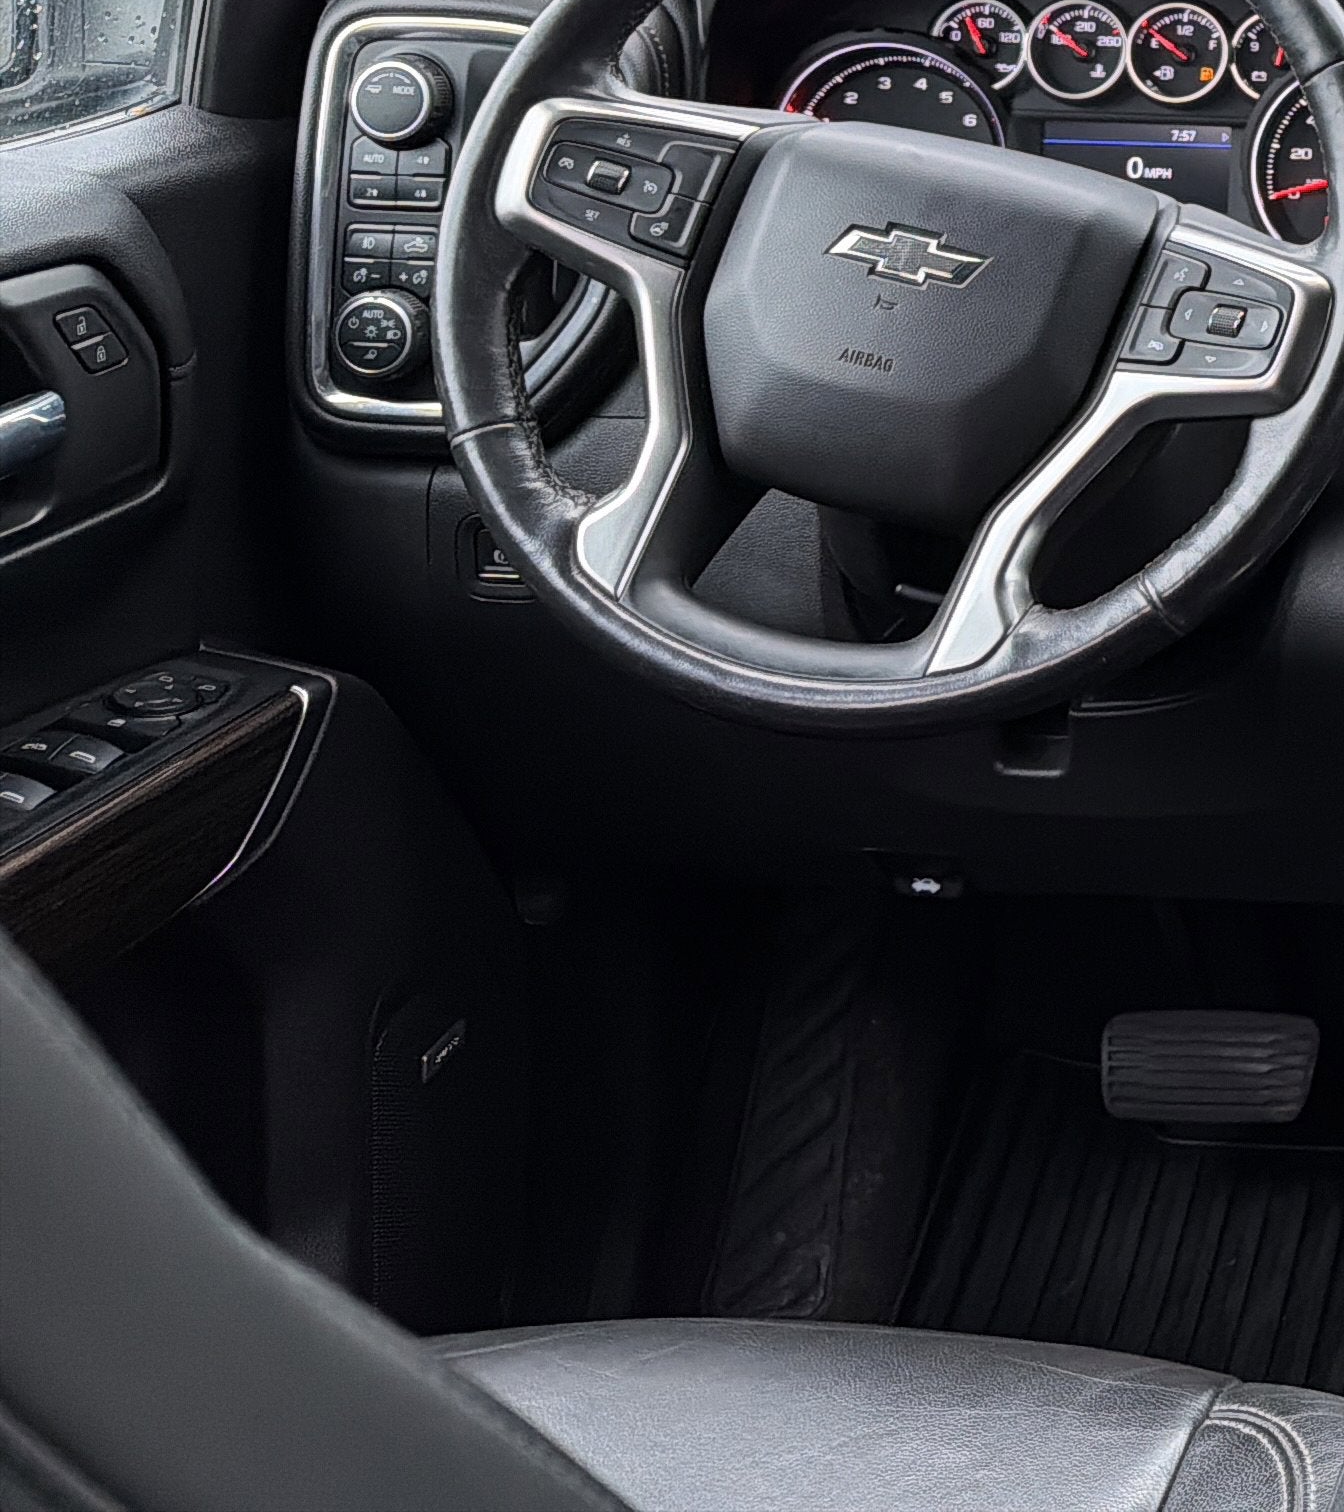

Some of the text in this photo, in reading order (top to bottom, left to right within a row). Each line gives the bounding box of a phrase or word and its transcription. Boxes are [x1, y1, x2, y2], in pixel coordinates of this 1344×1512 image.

[976, 18, 995, 29] 60
[1074, 21, 1096, 32] 210
[951, 30, 961, 41] 0
[1176, 25, 1194, 36] 1/2
[999, 32, 1021, 43] 120
[1097, 36, 1122, 47] 260
[1150, 38, 1159, 49] E
[1208, 40, 1218, 50] F
[1250, 42, 1260, 52] 9
[878, 76, 892, 90] 3
[913, 77, 928, 90] 4
[392, 85, 416, 96] MODE
[843, 91, 859, 105] 2
[939, 91, 953, 104] 5
[962, 113, 977, 127] 6
[1170, 130, 1197, 142] 7:57
[363, 154, 385, 163] AUTO
[1289, 147, 1313, 160] 20
[1126, 156, 1172, 180] 0 MPH
[362, 309, 384, 318] AUTO
[838, 347, 895, 373] AIRBAG
